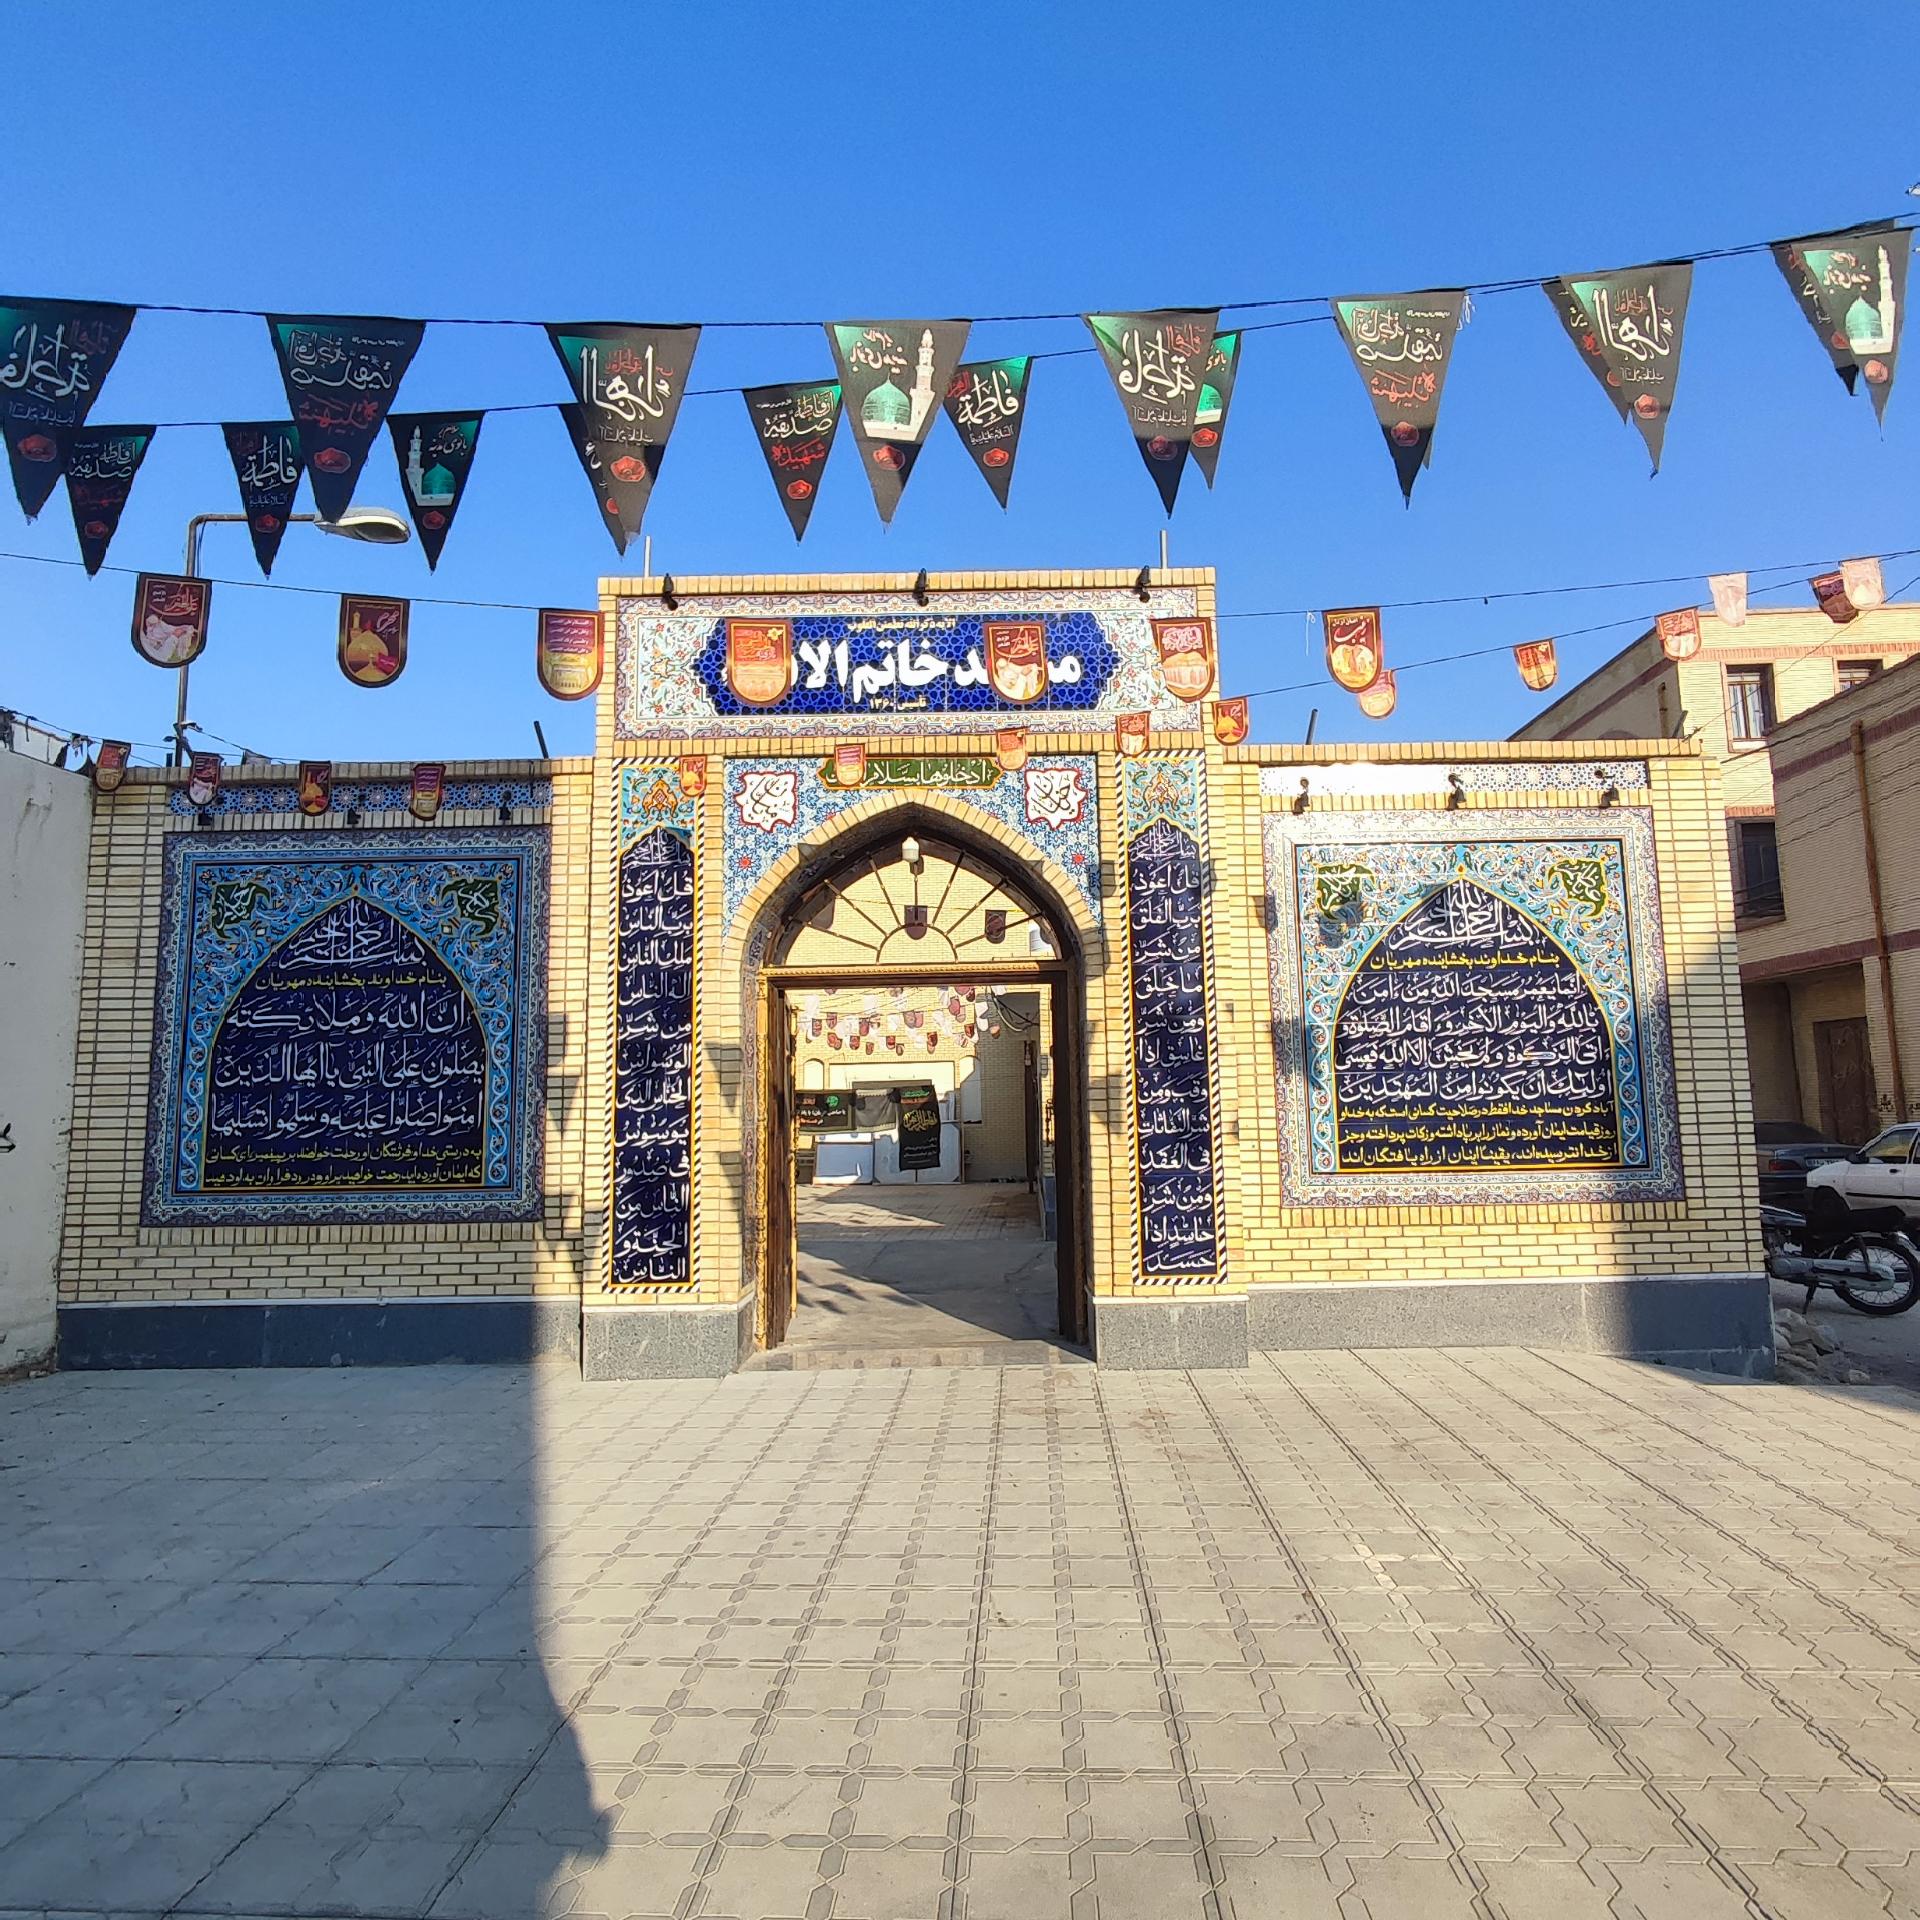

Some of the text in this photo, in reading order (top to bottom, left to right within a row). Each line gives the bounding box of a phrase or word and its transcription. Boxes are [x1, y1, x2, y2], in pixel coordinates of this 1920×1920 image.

[853, 639, 947, 702] خاتم
[1370, 950, 1559, 970] بنام خداوند بخشاینده مهربان
[255, 973, 305, 991] مهربان
[368, 969, 417, 989] خداوند
[419, 969, 447, 988] بنام
[1488, 1102, 1509, 1116] فقط
[1509, 1102, 1528, 1114] خدا
